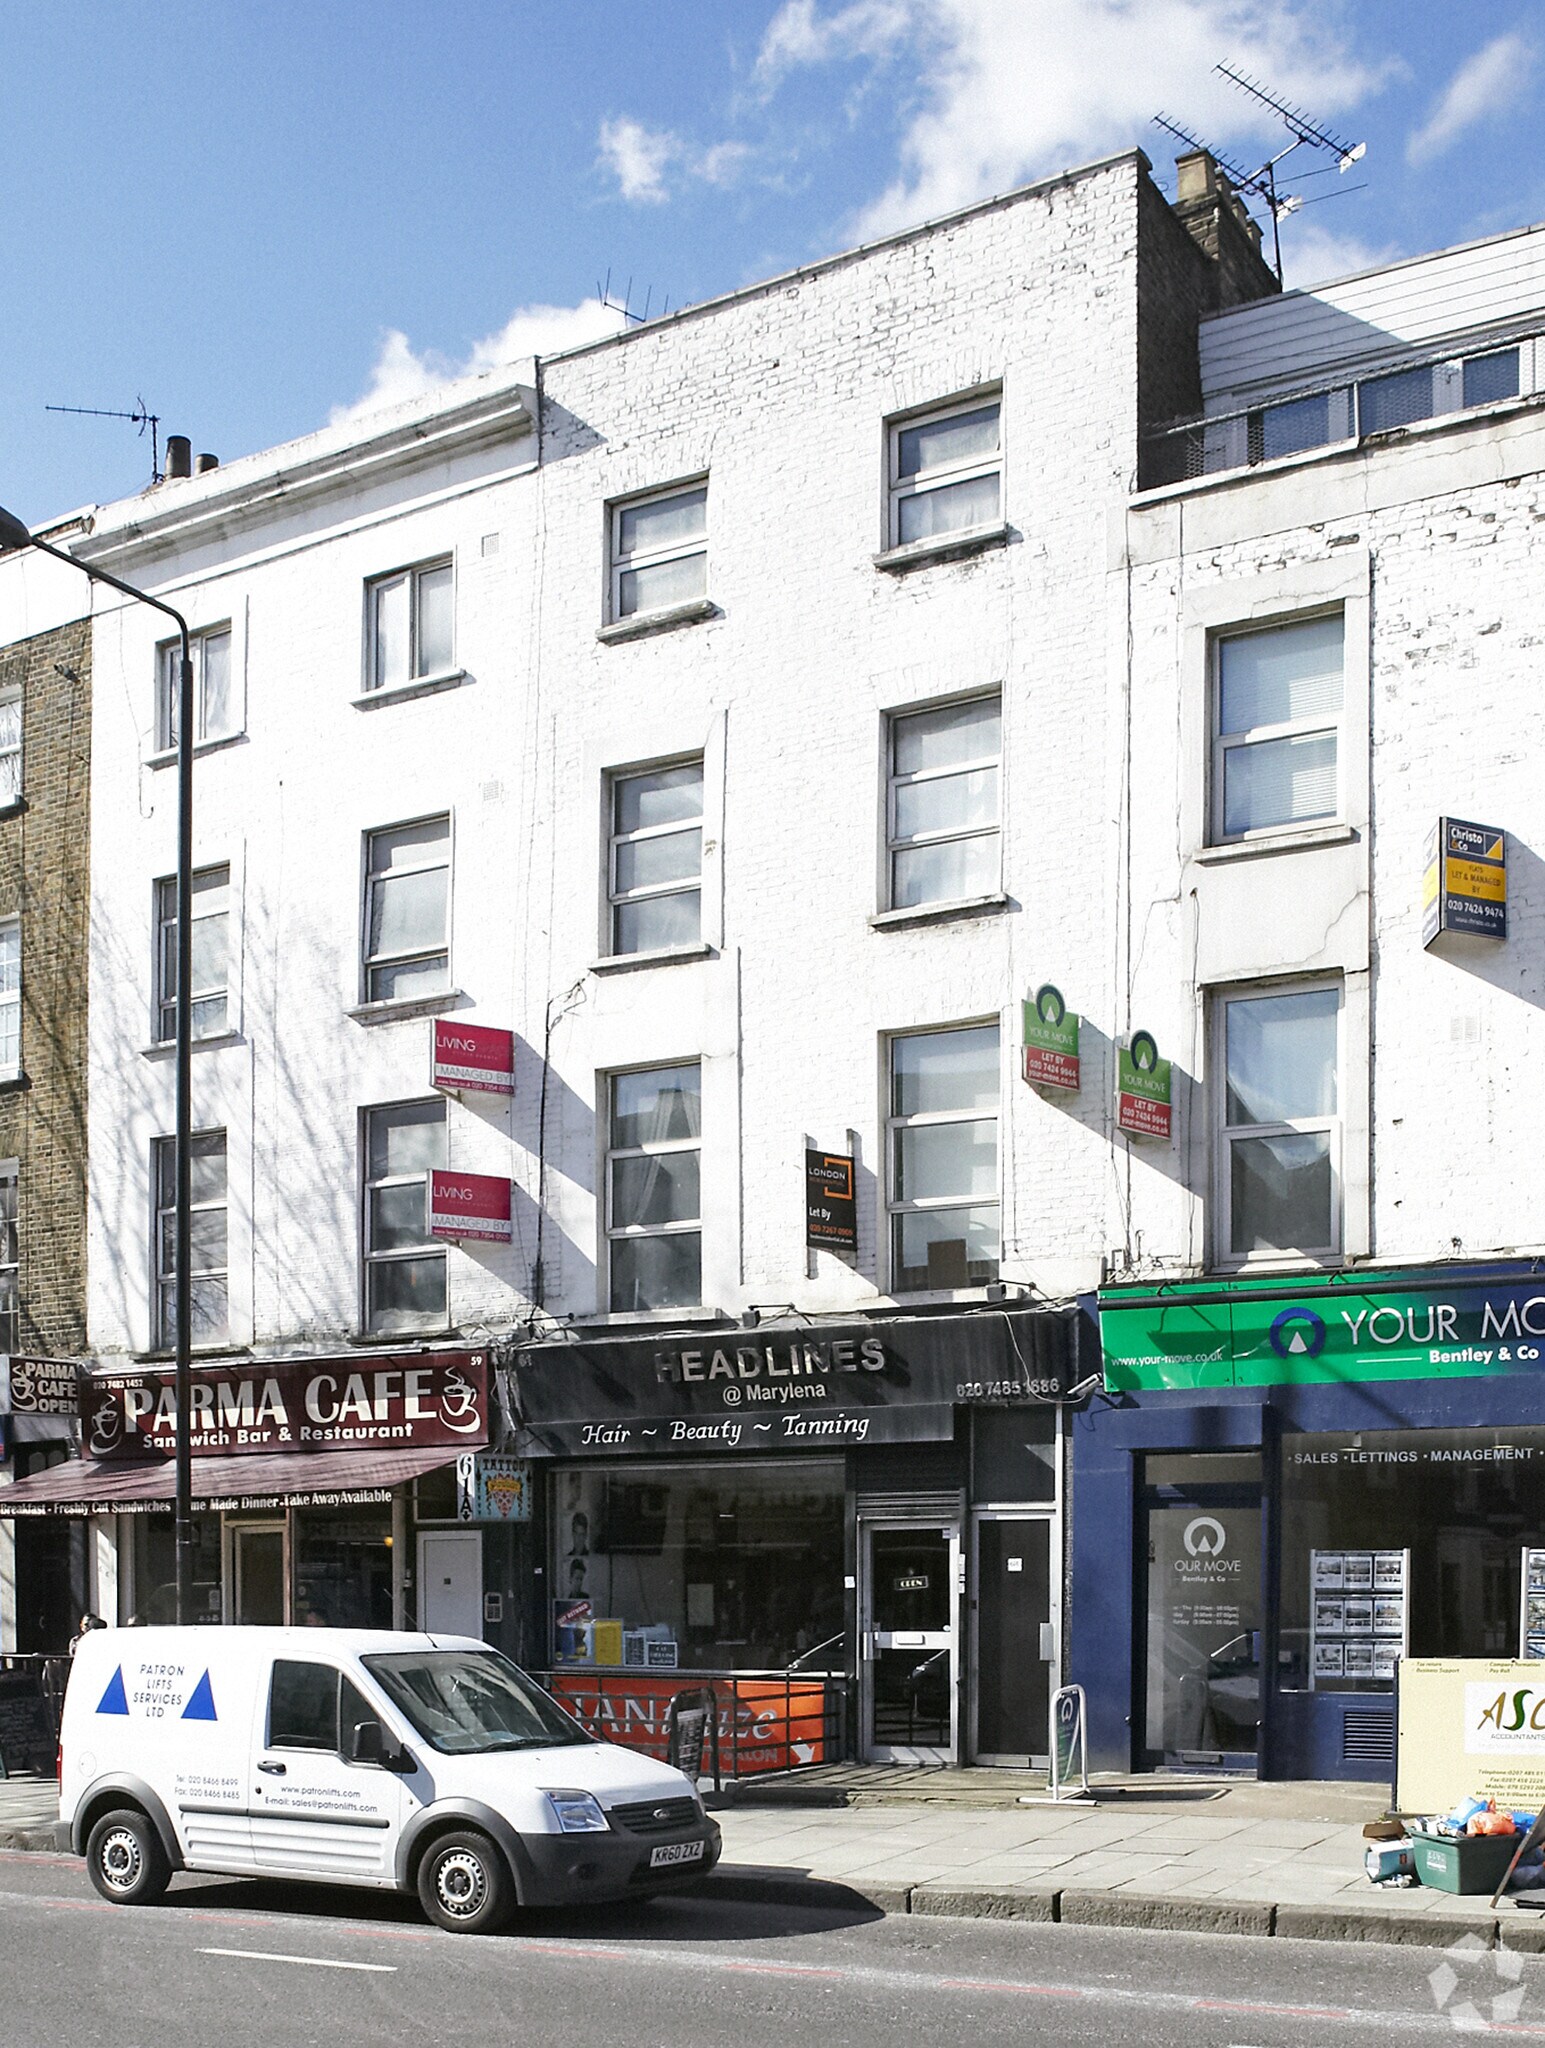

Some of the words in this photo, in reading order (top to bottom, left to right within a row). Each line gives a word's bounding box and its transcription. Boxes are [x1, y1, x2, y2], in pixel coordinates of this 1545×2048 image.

[1451, 828, 1483, 844] Christo
[1458, 841, 1468, 851] Co
[1452, 870, 1462, 880] LET
[1448, 899, 1462, 911] 020
[1464, 902, 1483, 915] 7424
[1485, 906, 1504, 919] 9474
[436, 1035, 476, 1052] LIVING
[1029, 1027, 1050, 1039] YOUR
[1052, 1032, 1074, 1045] MOVE
[1042, 1052, 1054, 1062] LET
[1055, 1055, 1065, 1065] BY
[440, 1066, 493, 1081] MANAGED
[496, 1072, 510, 1083] BY
[1123, 1073, 1143, 1087] YOUR
[1144, 1080, 1166, 1093] MOVE
[1134, 1099, 1146, 1110] LET
[1147, 1103, 1157, 1112] BY
[808, 1167, 846, 1180] LONDON
[433, 1185, 473, 1200] LIVING
[808, 1206, 820, 1217] Let
[821, 1208, 831, 1221] By
[435, 1216, 490, 1229] MANAGED
[493, 1221, 506, 1231] BY
[1340, 1304, 1460, 1345] YOUR
[470, 1356, 483, 1366] 59
[654, 1338, 886, 1383] HEADLINES
[1111, 1352, 1223, 1368] www.your-move.co.uk
[1429, 1347, 1494, 1364] Bentley
[1498, 1346, 1512, 1361] &
[1517, 1345, 1540, 1360] Co
[25, 1361, 77, 1380] PARMA
[37, 1380, 77, 1398] CAFE
[93, 1380, 106, 1389] 020
[126, 1379, 144, 1388] 1452
[956, 1382, 983, 1397] 020
[985, 1380, 1020, 1396] 7485
[124, 1378, 289, 1433] PARMA
[304, 1369, 437, 1424] CAFE
[722, 1386, 742, 1407] @
[746, 1383, 827, 1403] Marylena
[38, 1398, 78, 1414] OPEN
[143, 1430, 230, 1449] Sanwich
[237, 1429, 272, 1444] Bar
[278, 1426, 292, 1441] &
[300, 1422, 413, 1441] Restaurant
[581, 1424, 631, 1445] Hair
[670, 1420, 743, 1446] Beauty
[782, 1412, 870, 1440] Tanning
[1294, 1452, 1338, 1464] SALES
[1351, 1450, 1418, 1463] LETTINGS
[1430, 1448, 1534, 1461] MANAGEMENT
[460, 1455, 473, 1513] 61A
[0, 1503, 46, 1515] Breakfast
[54, 1502, 89, 1516] Freshly
[91, 1501, 109, 1513] Cut
[112, 1500, 171, 1514] Sandwiches
[209, 1497, 238, 1510] Made
[1203, 1559, 1241, 1572] MOVE
[140, 1664, 185, 1676] PATRON
[147, 1679, 172, 1690] LIFTS
[133, 1692, 182, 1705] SERVICES
[146, 1706, 165, 1718] LTD
[188, 1775, 201, 1784] 020
[189, 1788, 202, 1797] 020
[280, 1785, 361, 1799] www.patronlifts.com
[265, 1796, 290, 1806] E-mail:
[291, 1798, 378, 1813] sales@patronlifts.com
[655, 1846, 681, 1863] KR60
[682, 1842, 701, 1859] ZXZ
